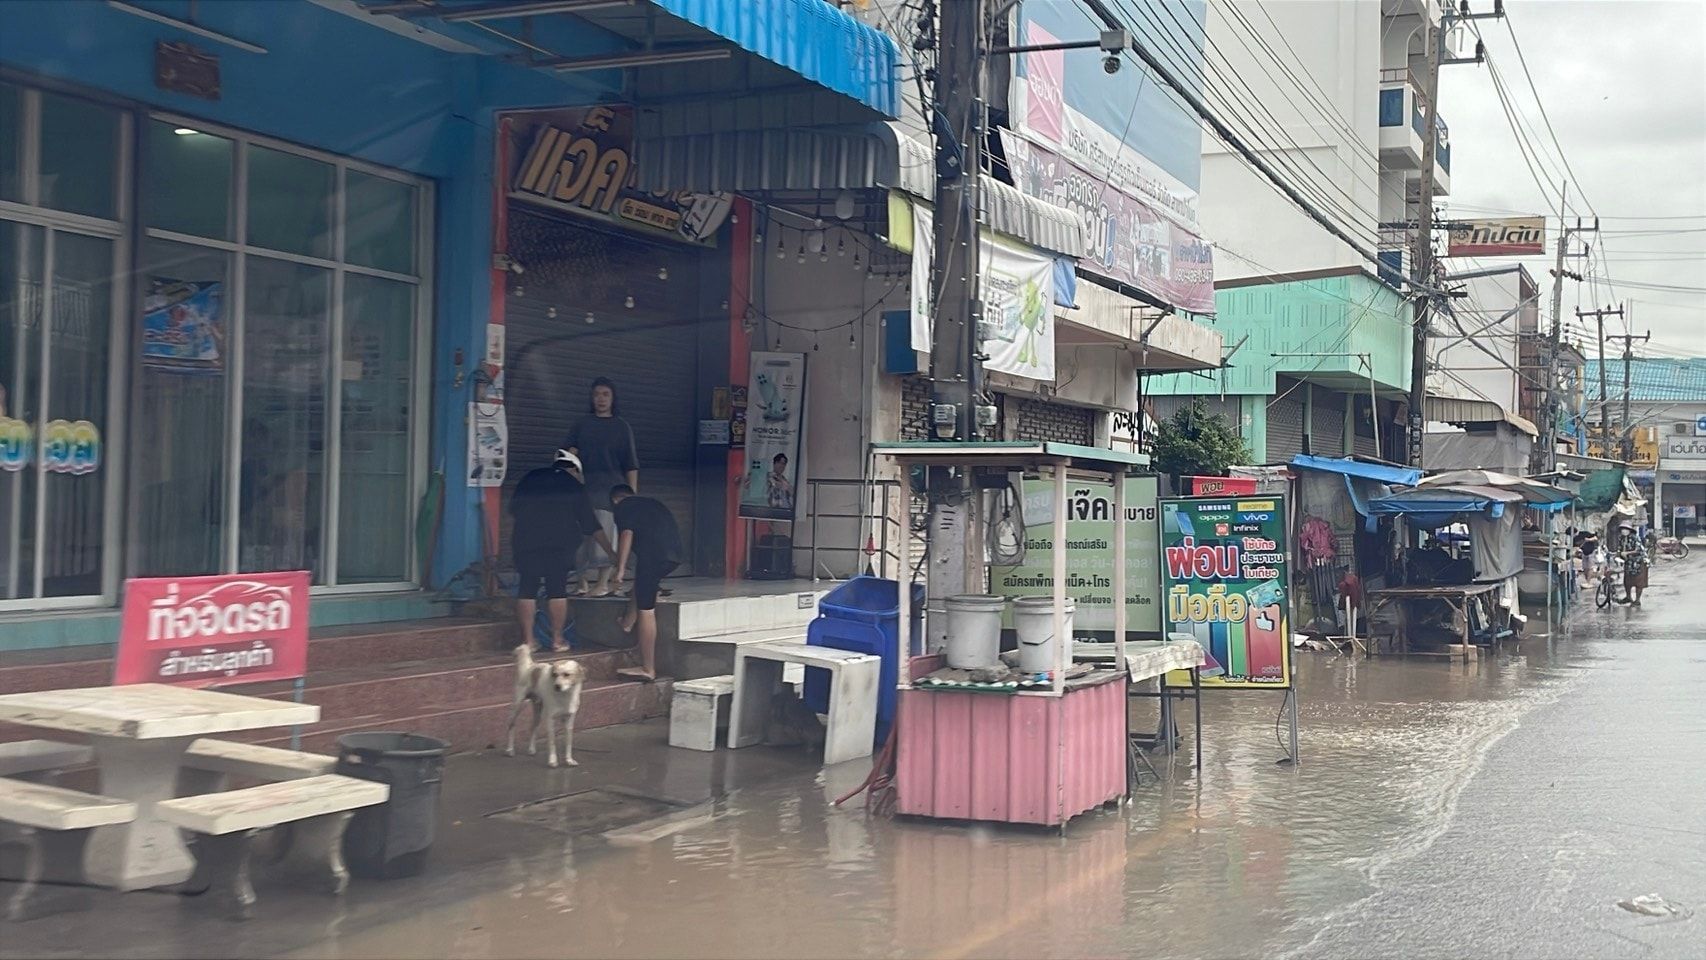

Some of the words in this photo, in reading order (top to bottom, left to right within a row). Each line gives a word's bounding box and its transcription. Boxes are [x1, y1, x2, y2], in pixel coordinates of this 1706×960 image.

[1111, 502, 1156, 521] โบาย
[1233, 524, 1259, 532] Infinix
[1166, 537, 1239, 577] ผ่อน
[1241, 553, 1284, 564] ประชาชน
[1169, 584, 1247, 622] มือถือ
[159, 641, 275, 677] สำหรับลูกค้า
